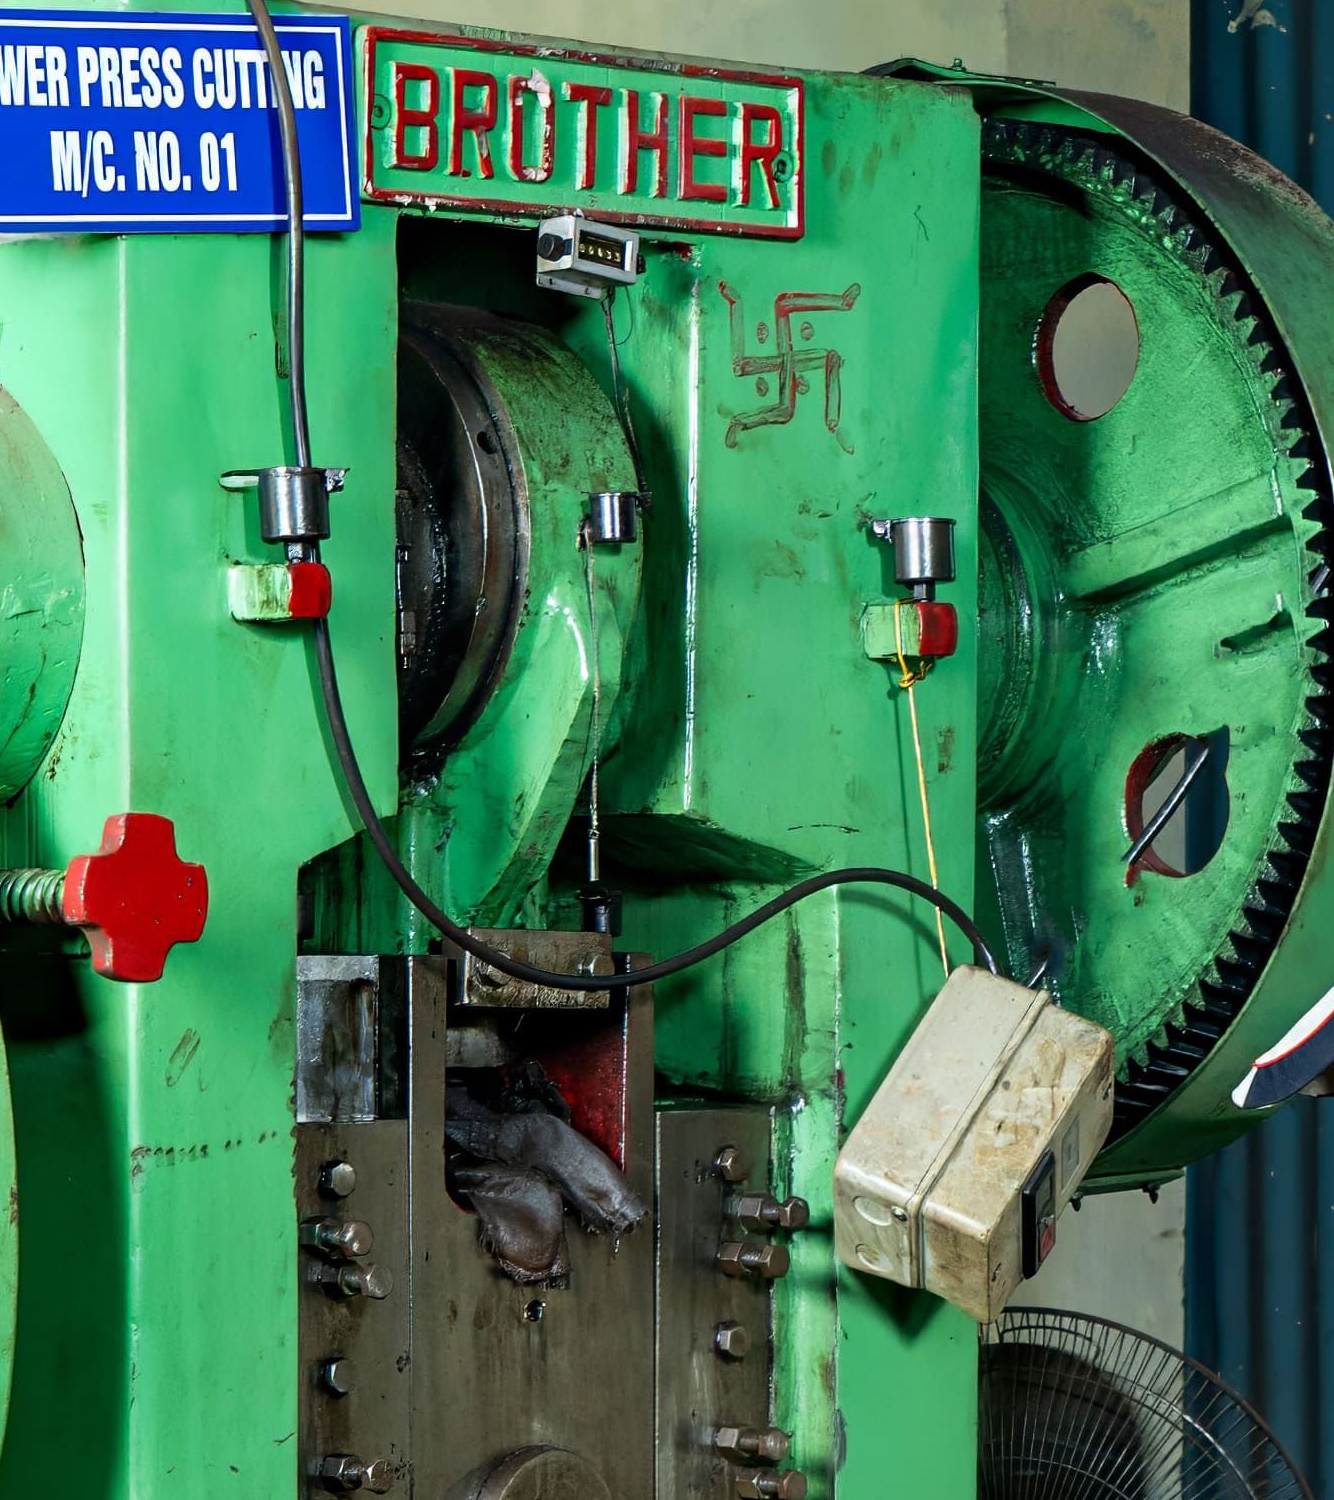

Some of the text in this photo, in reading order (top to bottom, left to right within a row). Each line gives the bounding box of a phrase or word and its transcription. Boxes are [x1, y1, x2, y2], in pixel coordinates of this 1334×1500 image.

[76, 46, 185, 109] PRESS
[192, 47, 326, 110] CUTTNG
[50, 130, 238, 198] M/C. NO. 01
[385, 61, 783, 209] BROTHER
